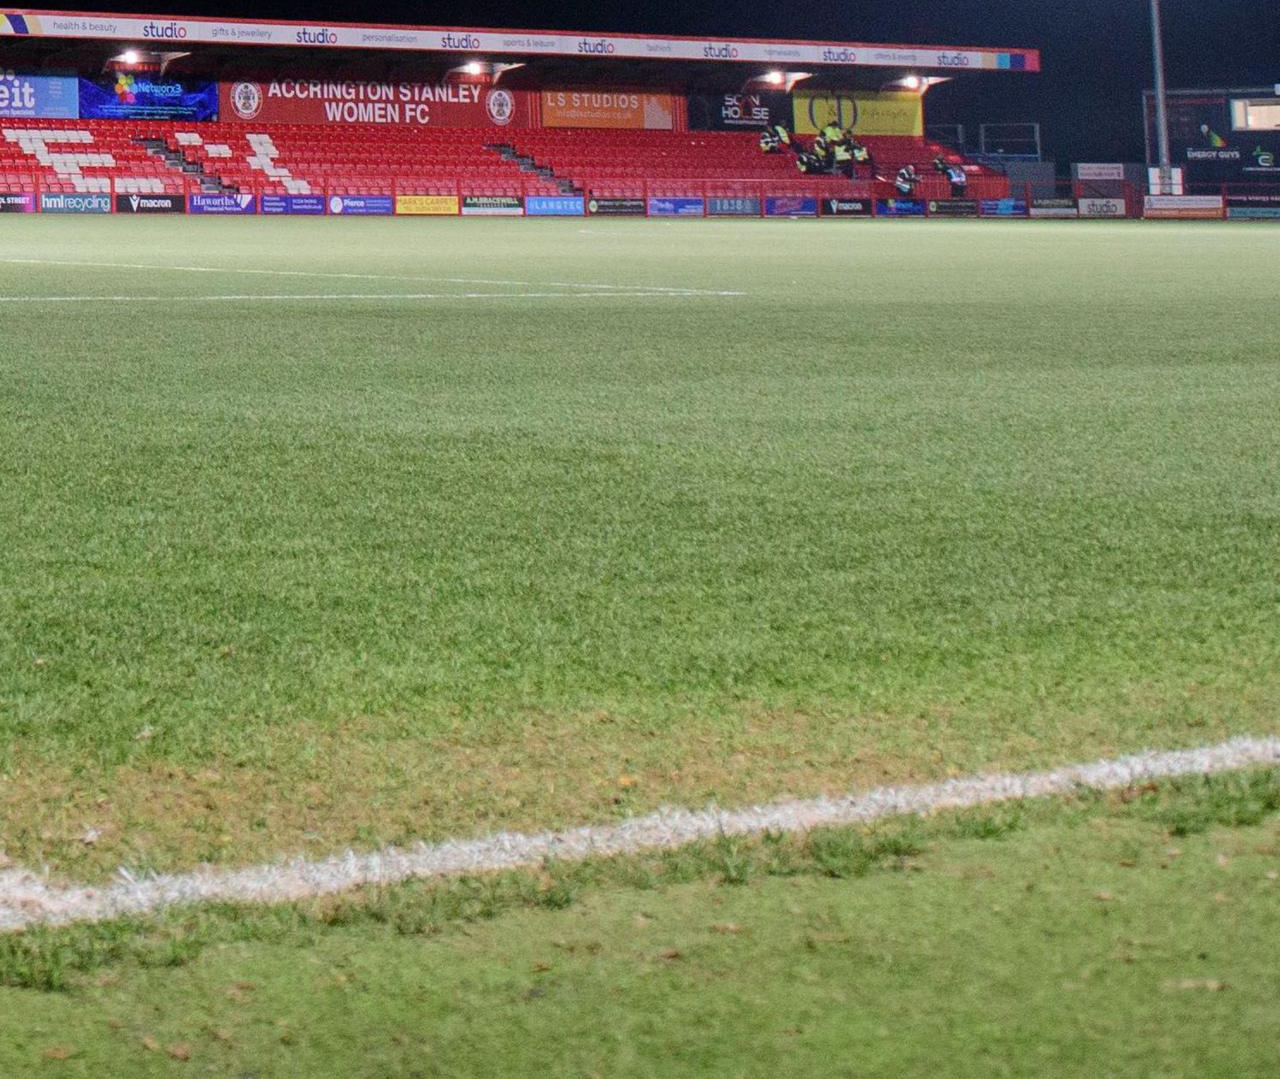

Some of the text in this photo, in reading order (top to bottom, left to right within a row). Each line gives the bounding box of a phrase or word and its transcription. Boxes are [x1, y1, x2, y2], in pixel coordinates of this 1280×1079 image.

[53, 21, 117, 33] health & beauty
[143, 22, 187, 39] studio
[212, 27, 227, 39] gifts
[238, 29, 272, 40] jewellery
[296, 28, 338, 44] studio
[441, 34, 480, 50] studio
[577, 39, 615, 54] studio
[703, 43, 739, 58] studio
[823, 48, 856, 62] studio
[937, 52, 970, 66] studio
[268, 80, 481, 104] ACCRINGTON STANLEY
[546, 92, 639, 108] LS STUDIOS
[325, 102, 430, 124] WOMEN FC
[6, 196, 29, 204] STREET
[140, 198, 172, 208] macron
[193, 195, 235, 206] Haworths
[343, 199, 365, 207] Pierce
[1087, 200, 1117, 213] studio
